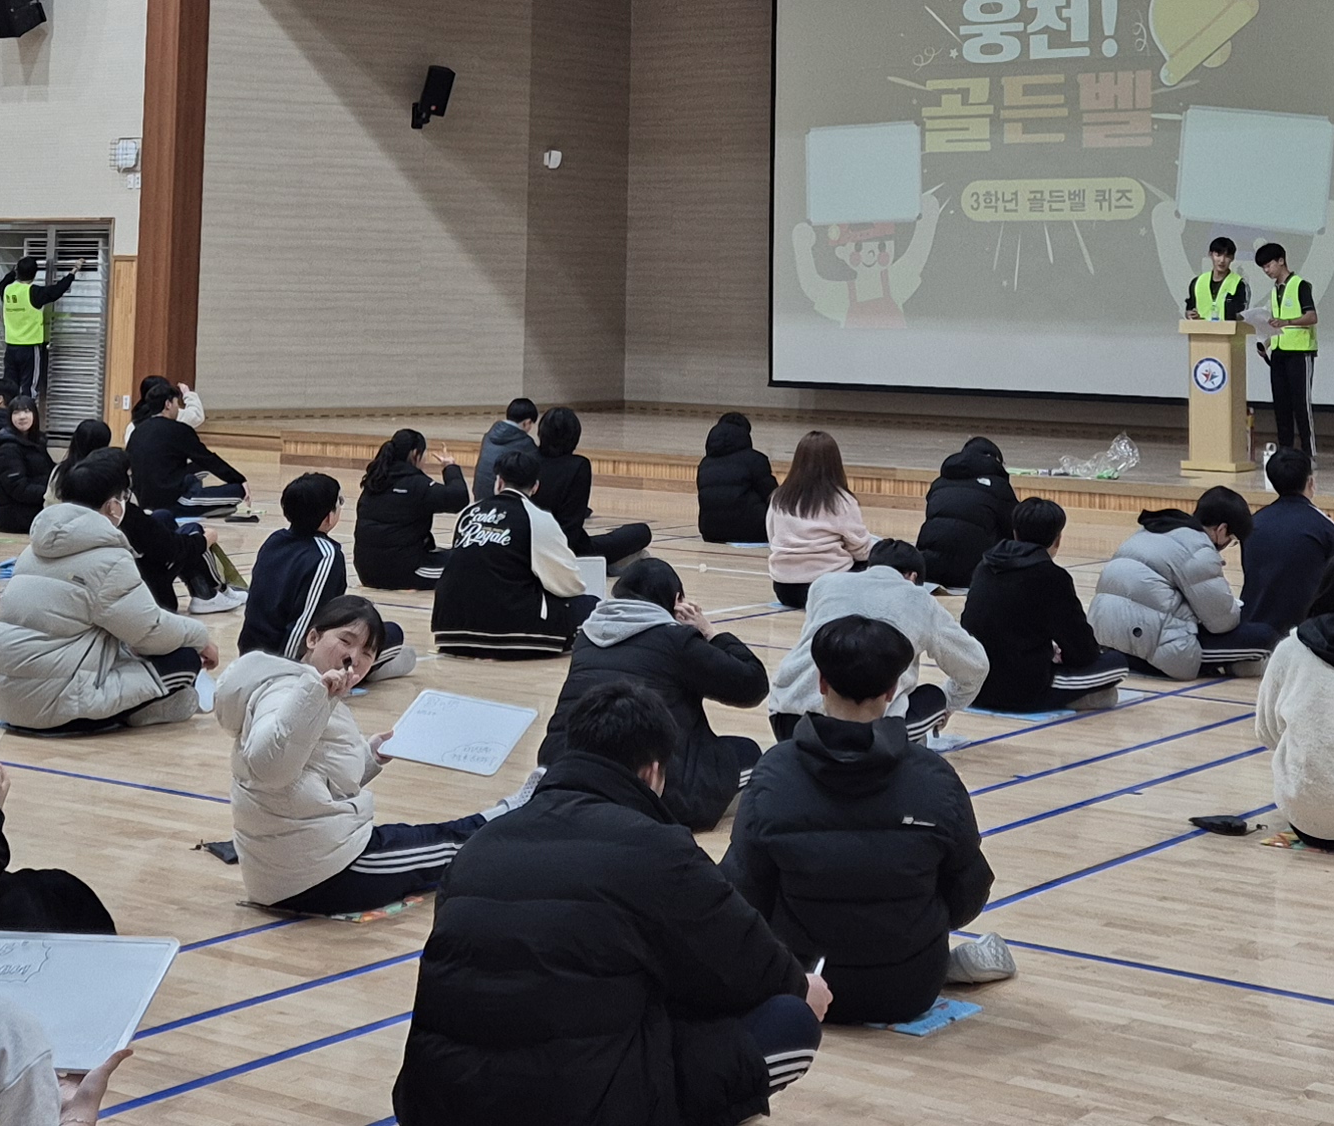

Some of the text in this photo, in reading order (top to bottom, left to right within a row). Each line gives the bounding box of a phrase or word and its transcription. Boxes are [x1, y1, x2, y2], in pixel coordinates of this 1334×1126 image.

[921, 69, 1154, 153] 골든벨
[970, 188, 1134, 214] 3학년 골든벨 퀴즈
[454, 522, 512, 548] Royale
